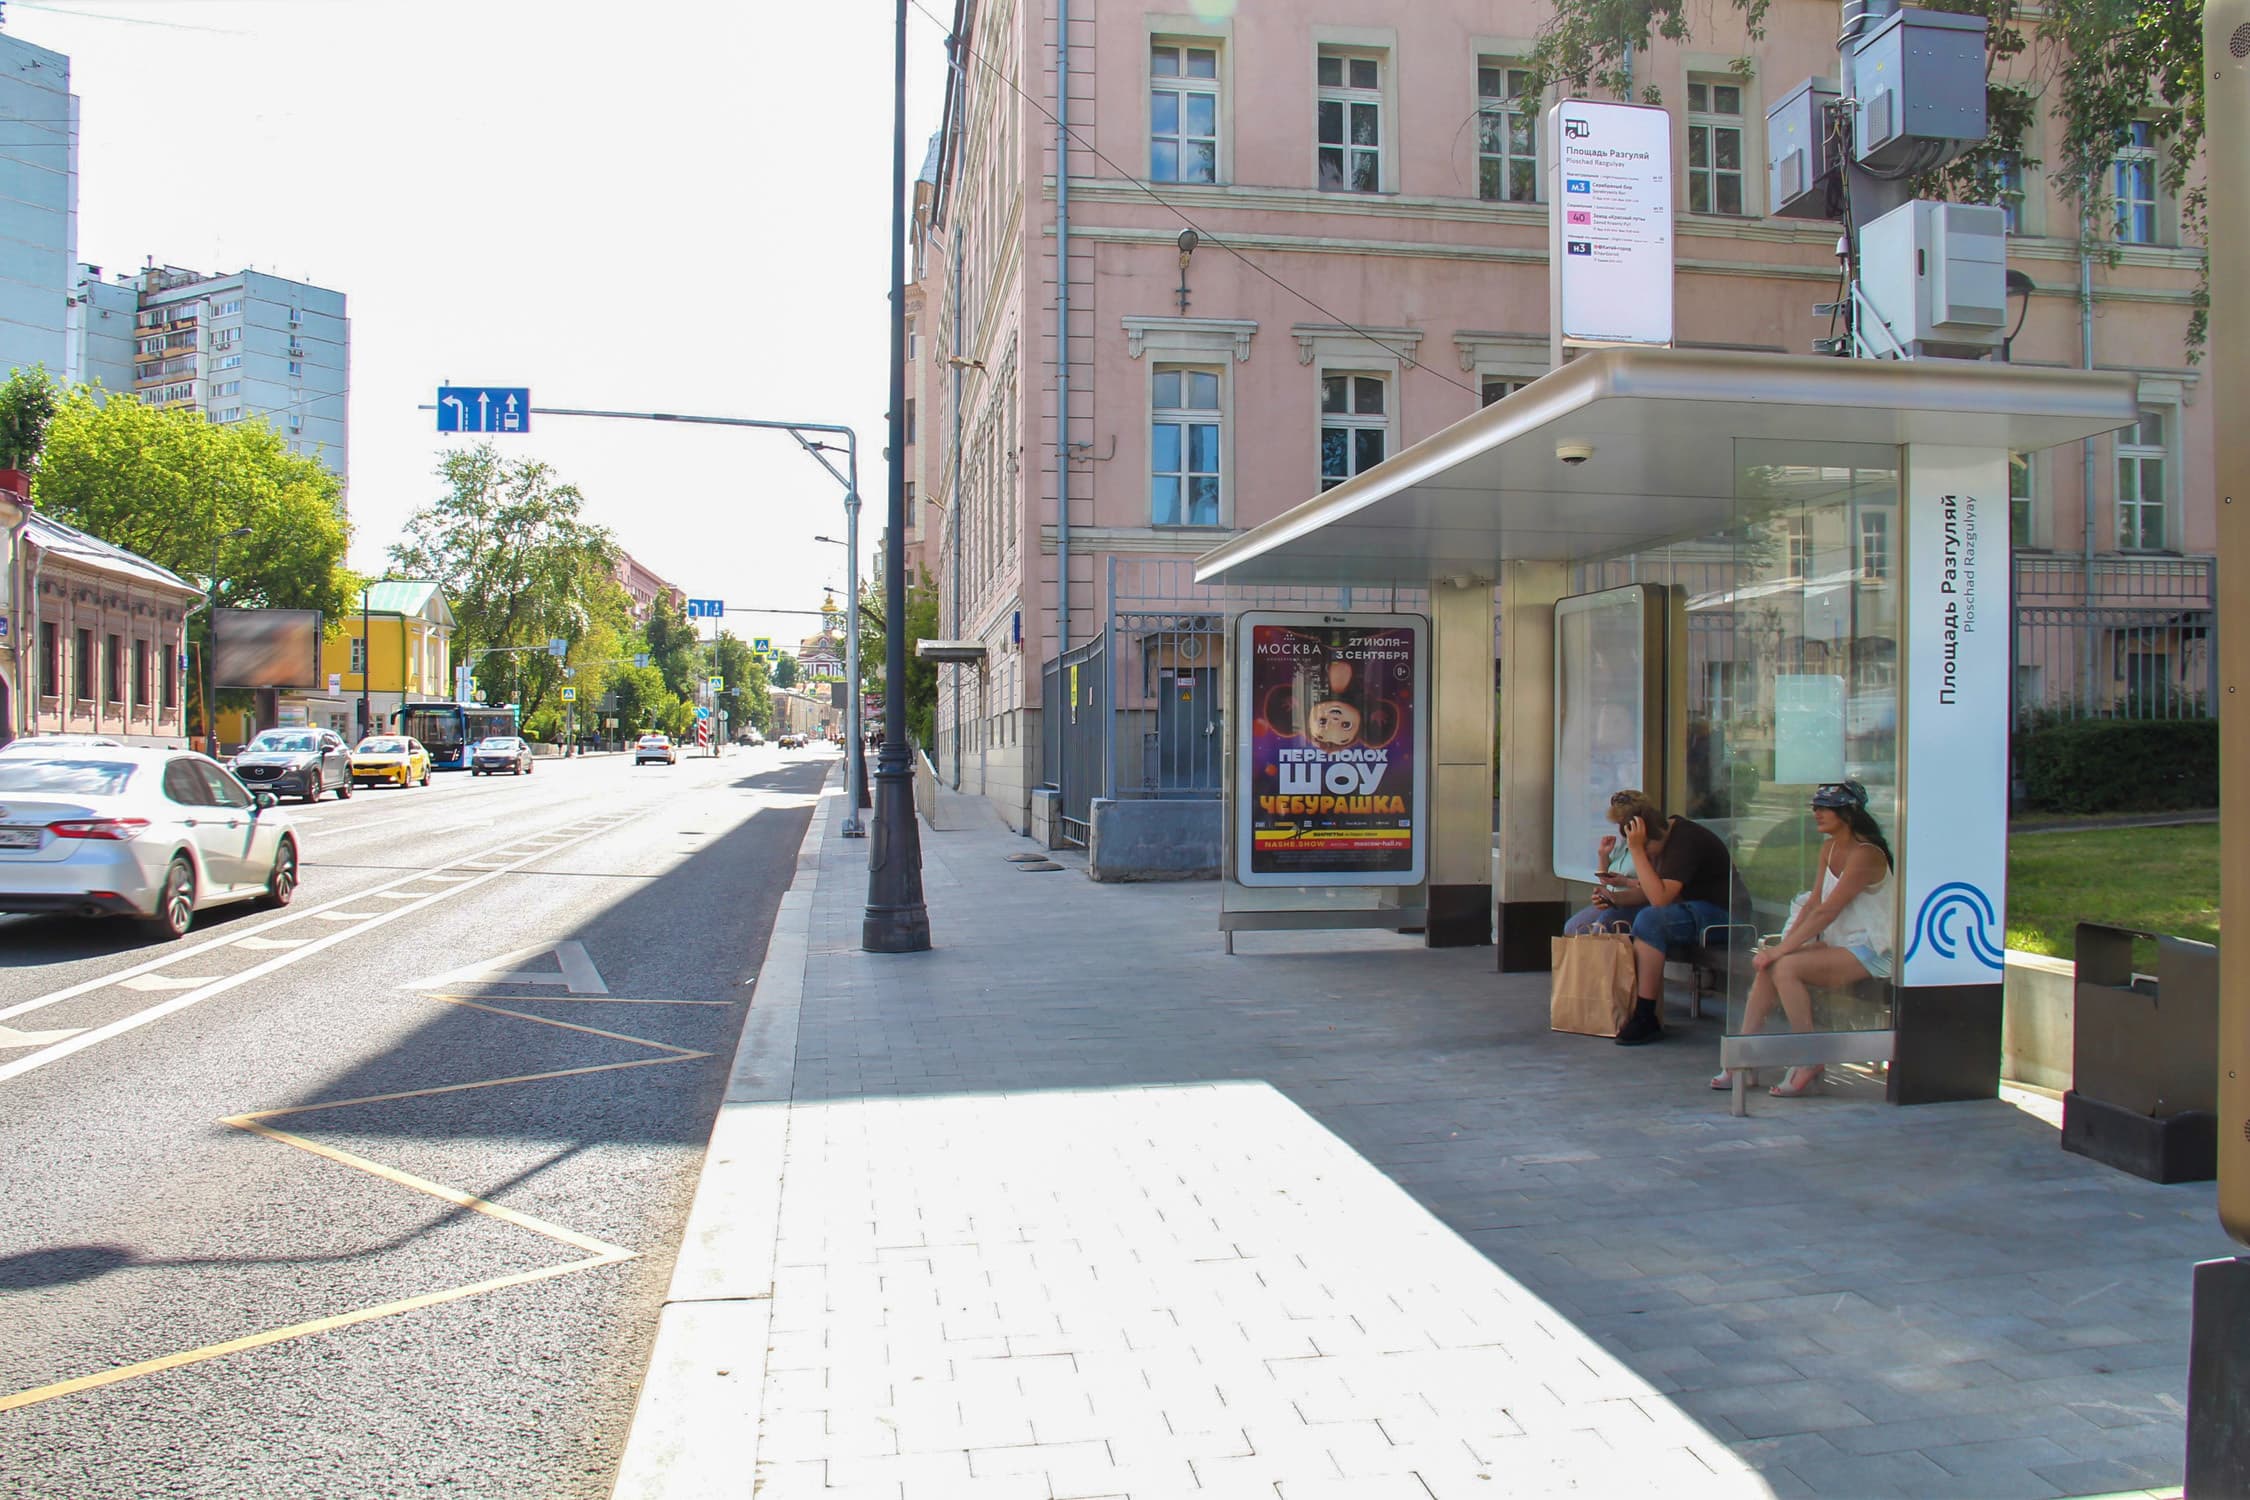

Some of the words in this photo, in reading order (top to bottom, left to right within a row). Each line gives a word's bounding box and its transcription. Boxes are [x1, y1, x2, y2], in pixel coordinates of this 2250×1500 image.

[1566, 146, 1608, 157] Площадь
[1610, 149, 1650, 161] Разгуляй
[1573, 213, 1585, 223] 40
[1963, 496, 1977, 566] Razgulyay
[1940, 495, 1961, 595] Разгуляй
[1963, 570, 1975, 633] Ploschad
[1257, 643, 1322, 655] МОСКВА
[1349, 638, 1363, 646] 27
[1336, 651, 1343, 660] 3
[1346, 651, 1409, 661] СЕНТЯБРЯ
[1940, 602, 1959, 705] Площадь
[1279, 749, 1388, 763] ПЕРЕПОЛОХ
[1279, 763, 1387, 795] ШОУ
[1260, 795, 1406, 815] ЧЕБУРАШКА
[1264, 840, 1326, 848] NASHE.SHOW
